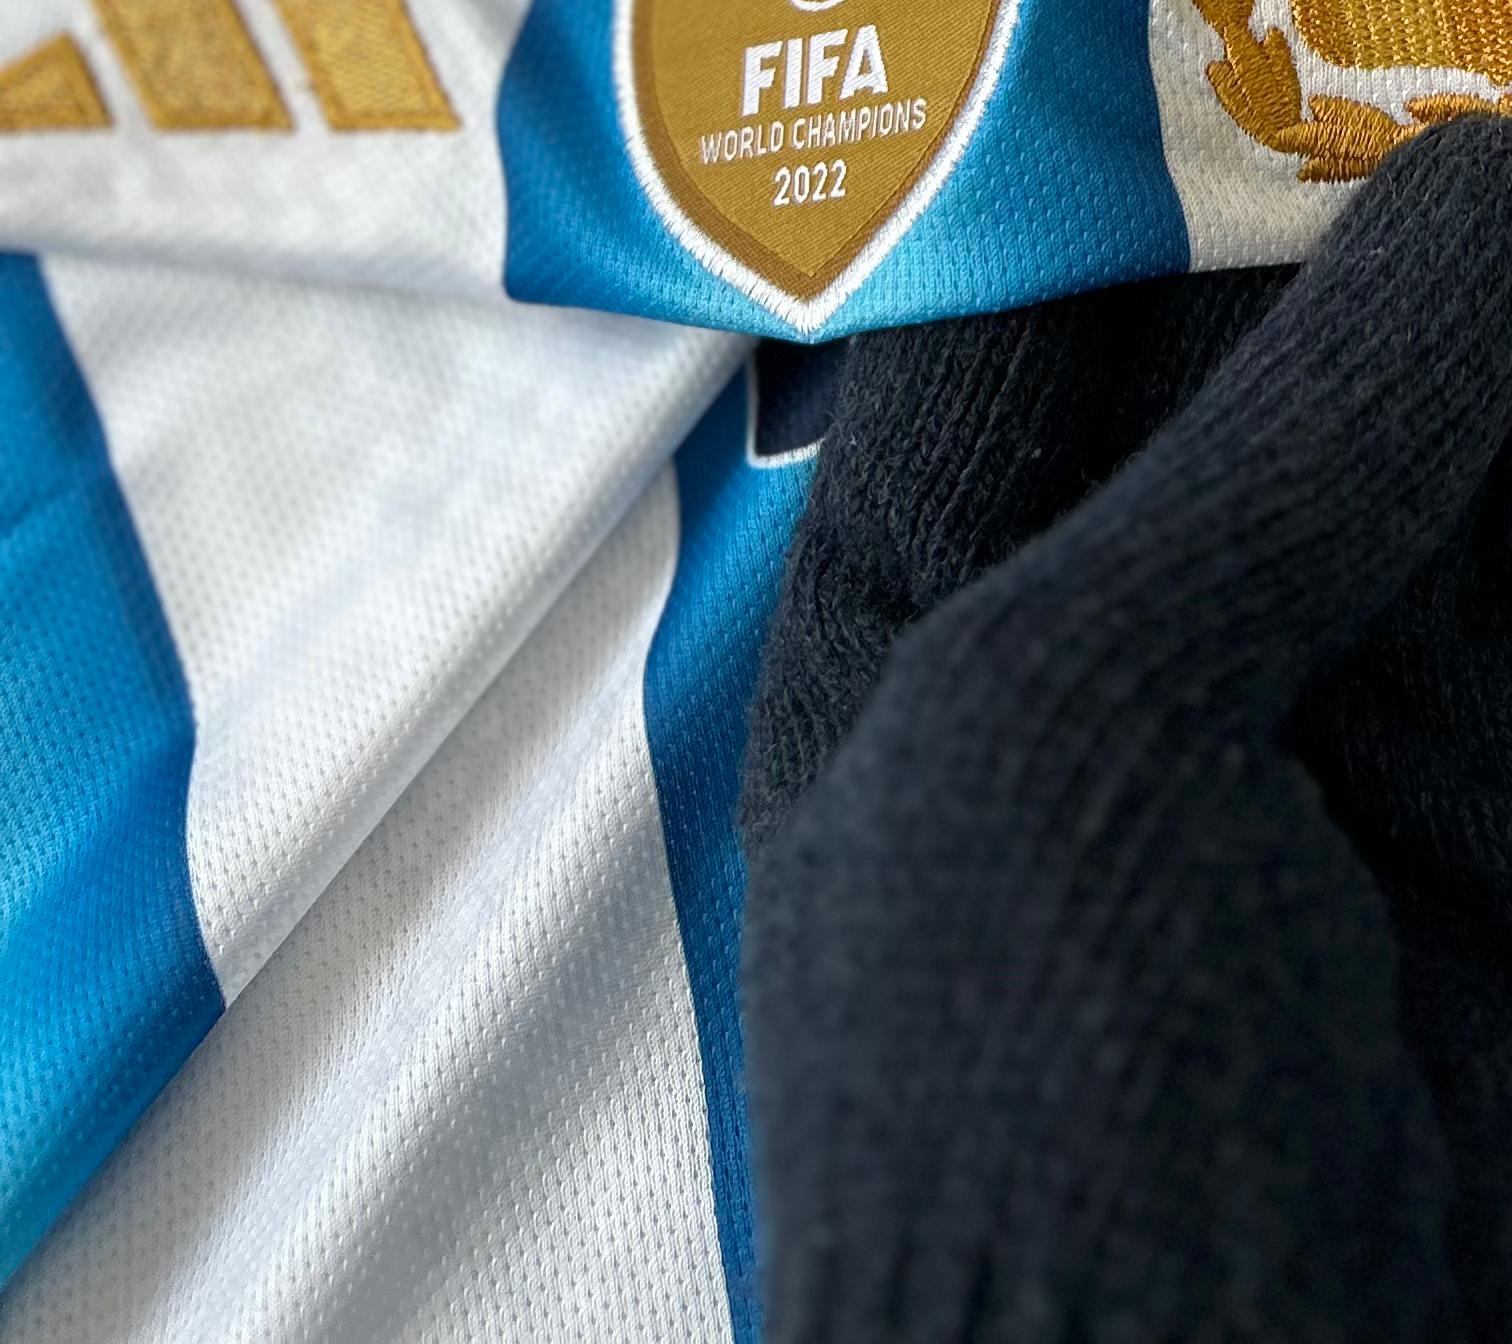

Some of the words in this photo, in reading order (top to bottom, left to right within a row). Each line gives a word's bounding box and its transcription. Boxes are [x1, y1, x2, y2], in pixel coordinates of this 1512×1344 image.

[741, 23, 889, 117] FIFA
[700, 118, 784, 164] WORLD
[791, 97, 928, 149] CHAMPIONS
[772, 159, 848, 207] 2022
